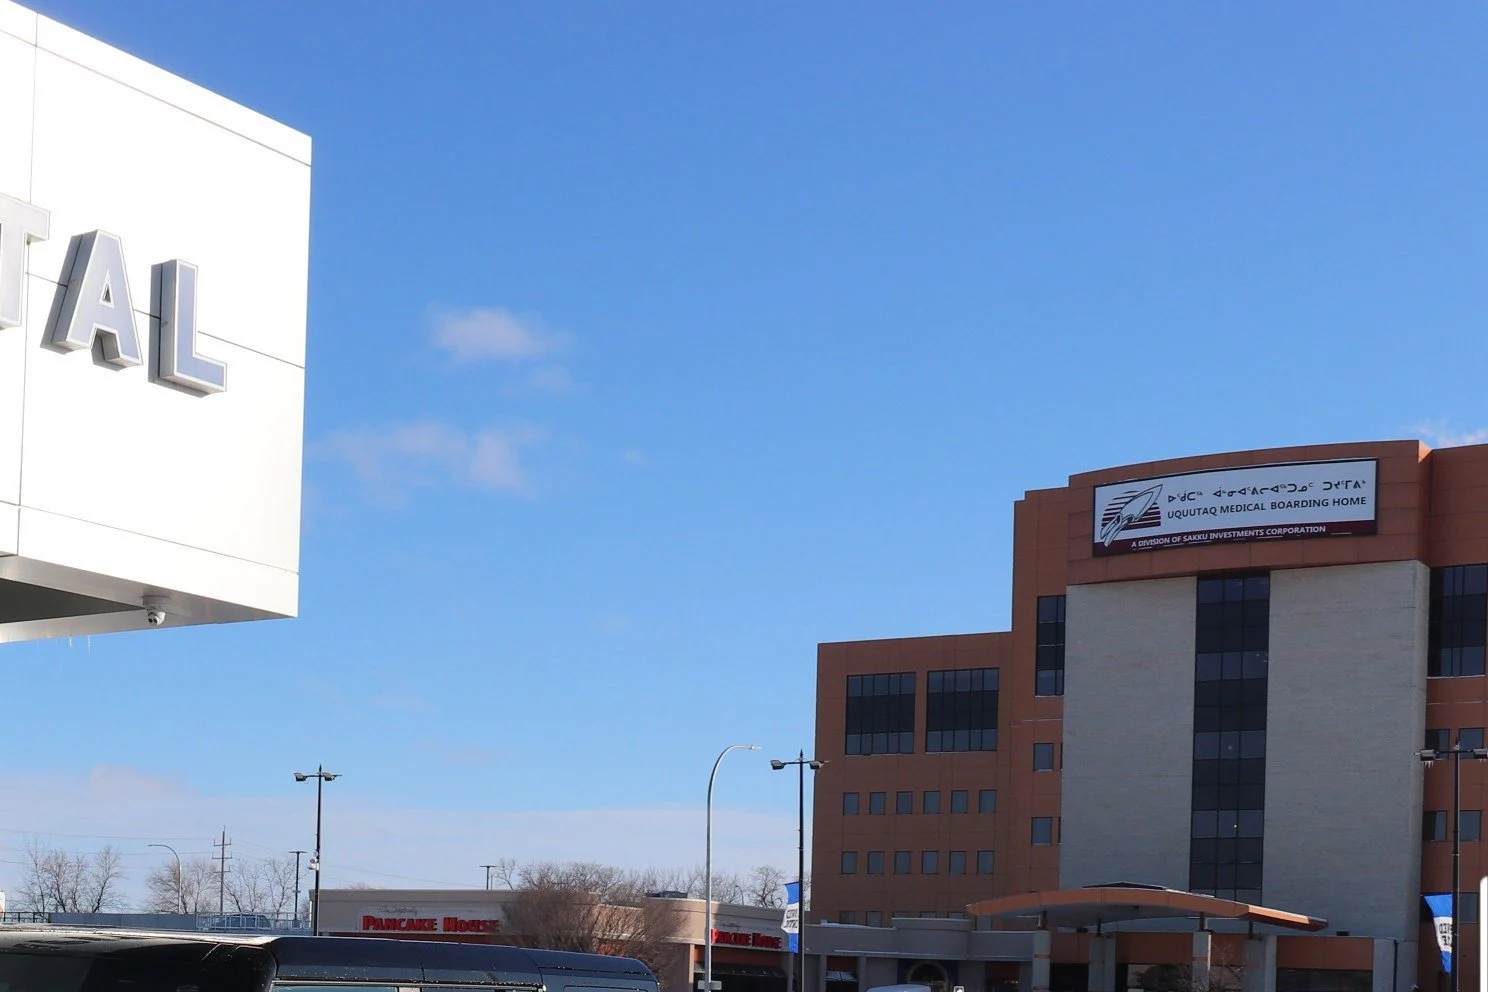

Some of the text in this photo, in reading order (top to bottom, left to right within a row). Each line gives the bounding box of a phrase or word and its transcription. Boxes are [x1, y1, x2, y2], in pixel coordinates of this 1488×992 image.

[1167, 496, 1367, 519] UQUUTAQ MEDICAL BOARDING HOME
[1138, 537, 1170, 547] DIVISION
[1183, 533, 1208, 542] SAKKU
[1209, 529, 1264, 540] INVESTMENTS
[1266, 525, 1327, 535] CORPORATION
[362, 915, 500, 933] PANCAKE HOUSE
